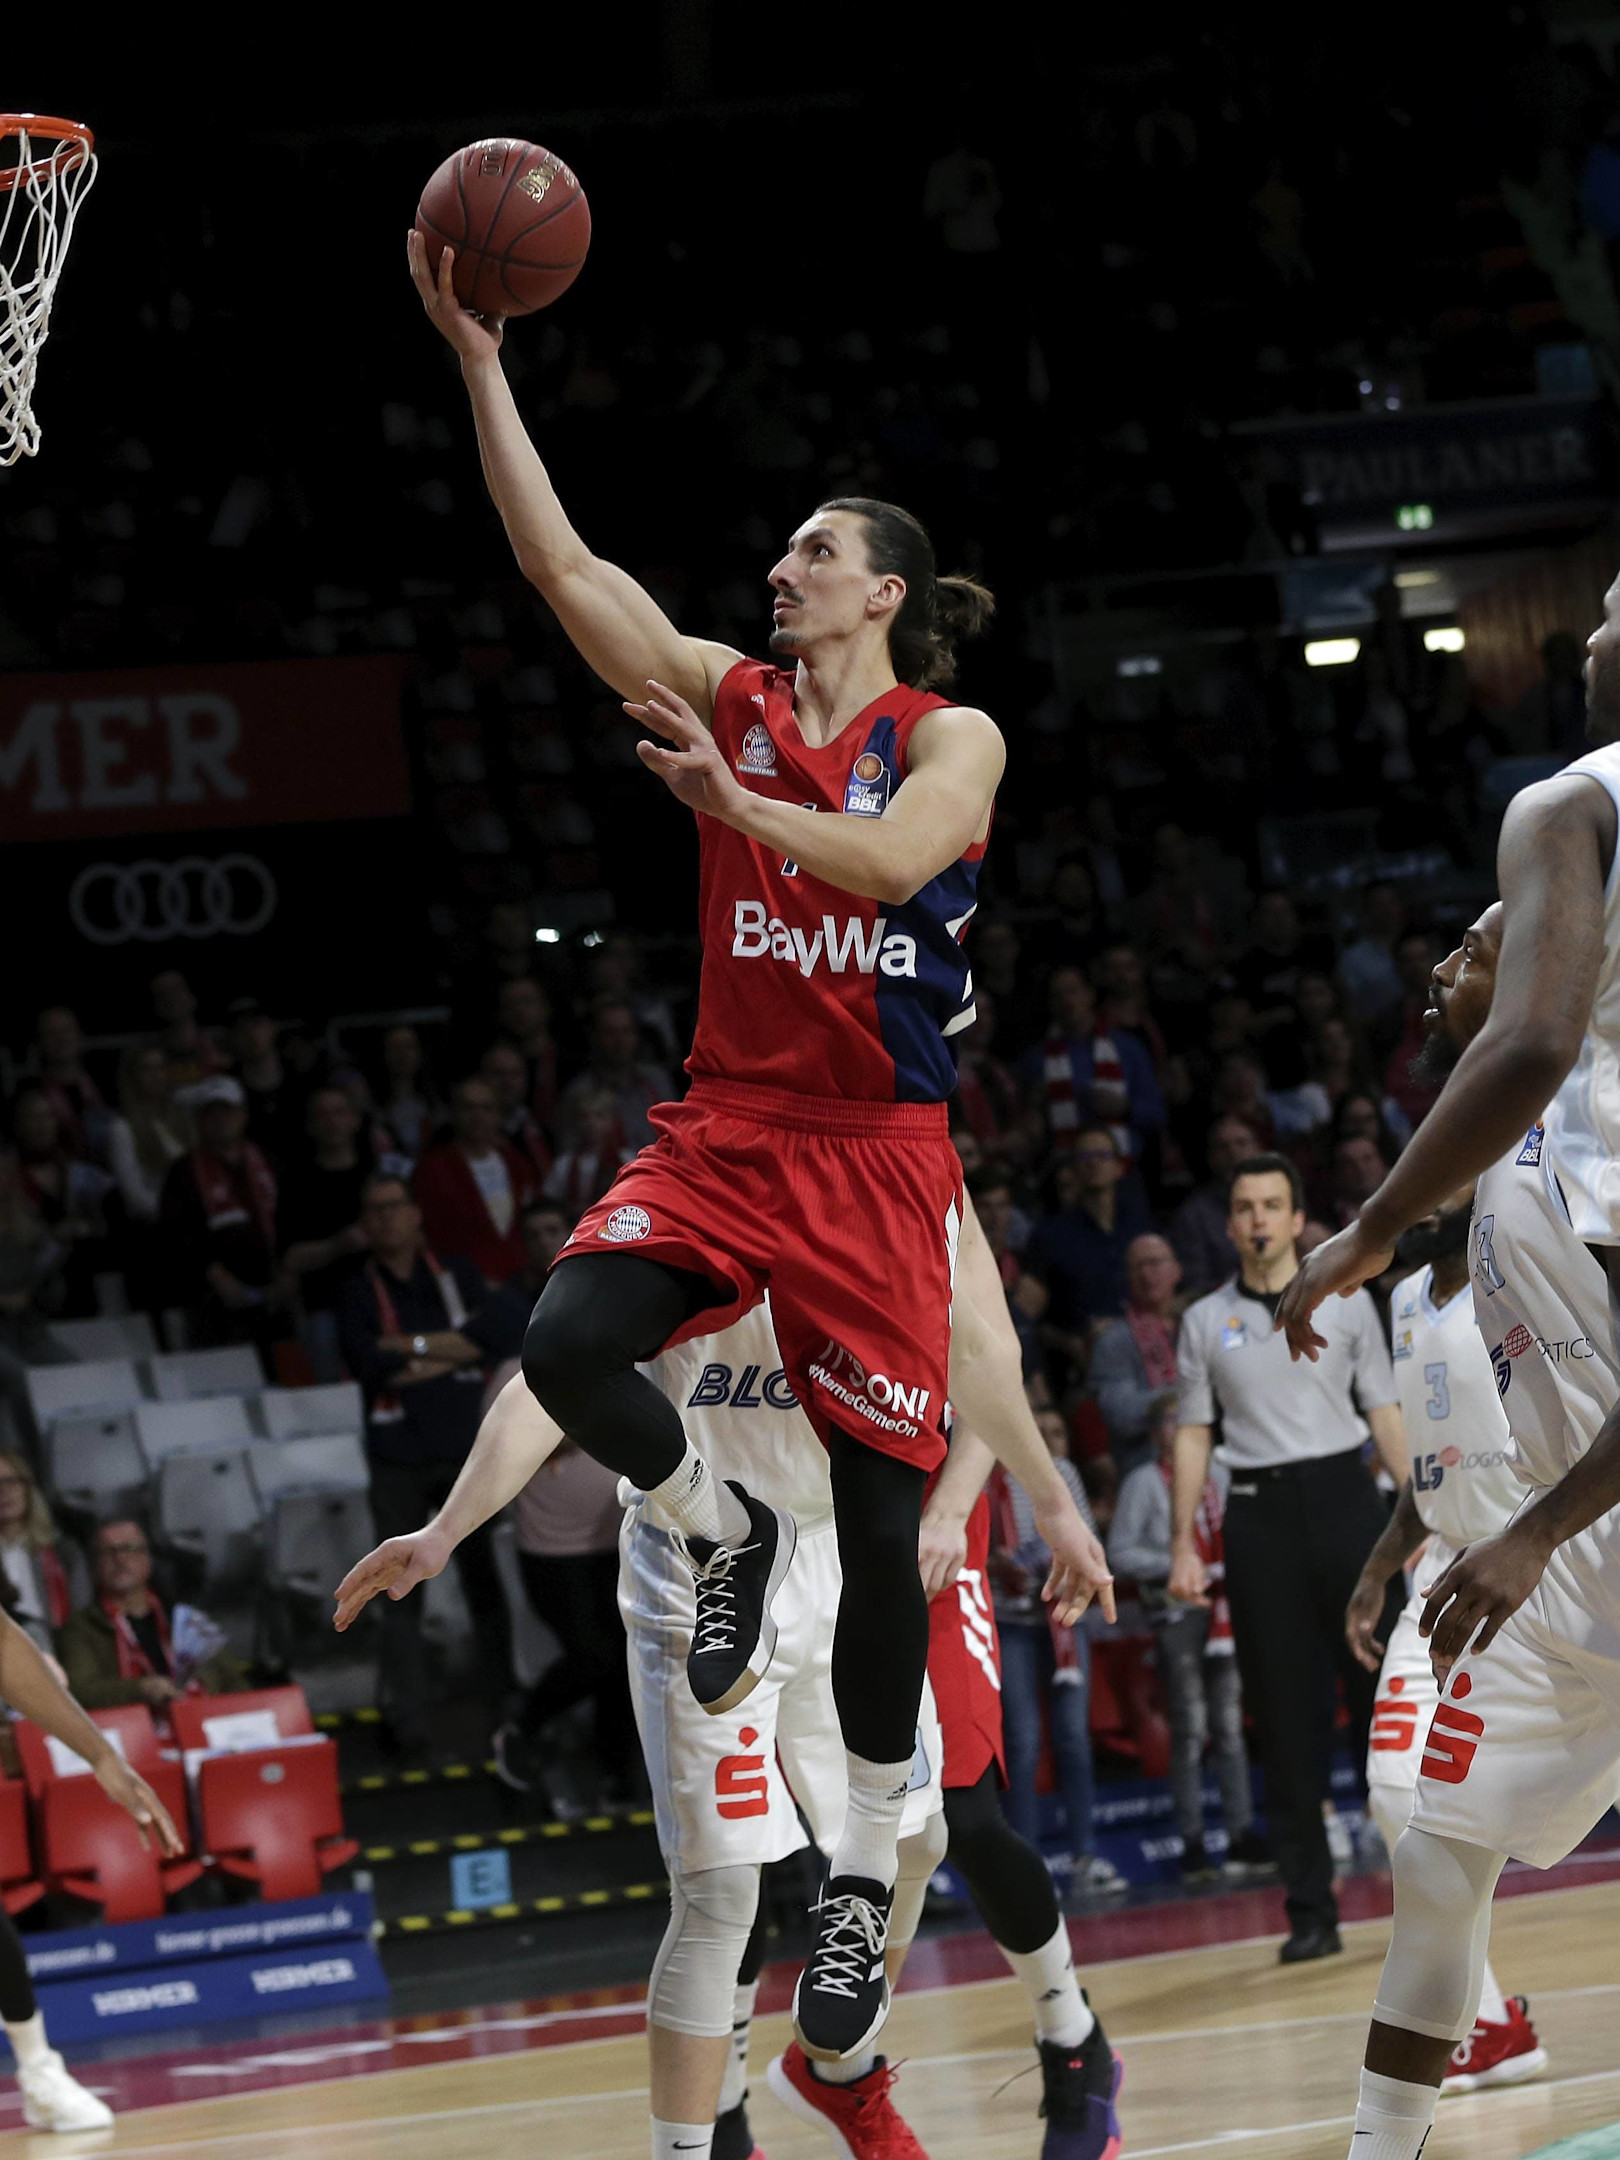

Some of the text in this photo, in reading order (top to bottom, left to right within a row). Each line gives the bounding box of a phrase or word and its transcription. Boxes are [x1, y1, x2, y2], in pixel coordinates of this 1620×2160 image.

[1302, 428, 1595, 502] PAULANER
[847, 795, 881, 813] BBL
[732, 900, 917, 978] BayWa
[687, 1363, 801, 1410] BLG
[808, 1363, 919, 1438] #NameGameOn
[866, 1373, 931, 1421] ON!
[1424, 1361, 1450, 1421] 3
